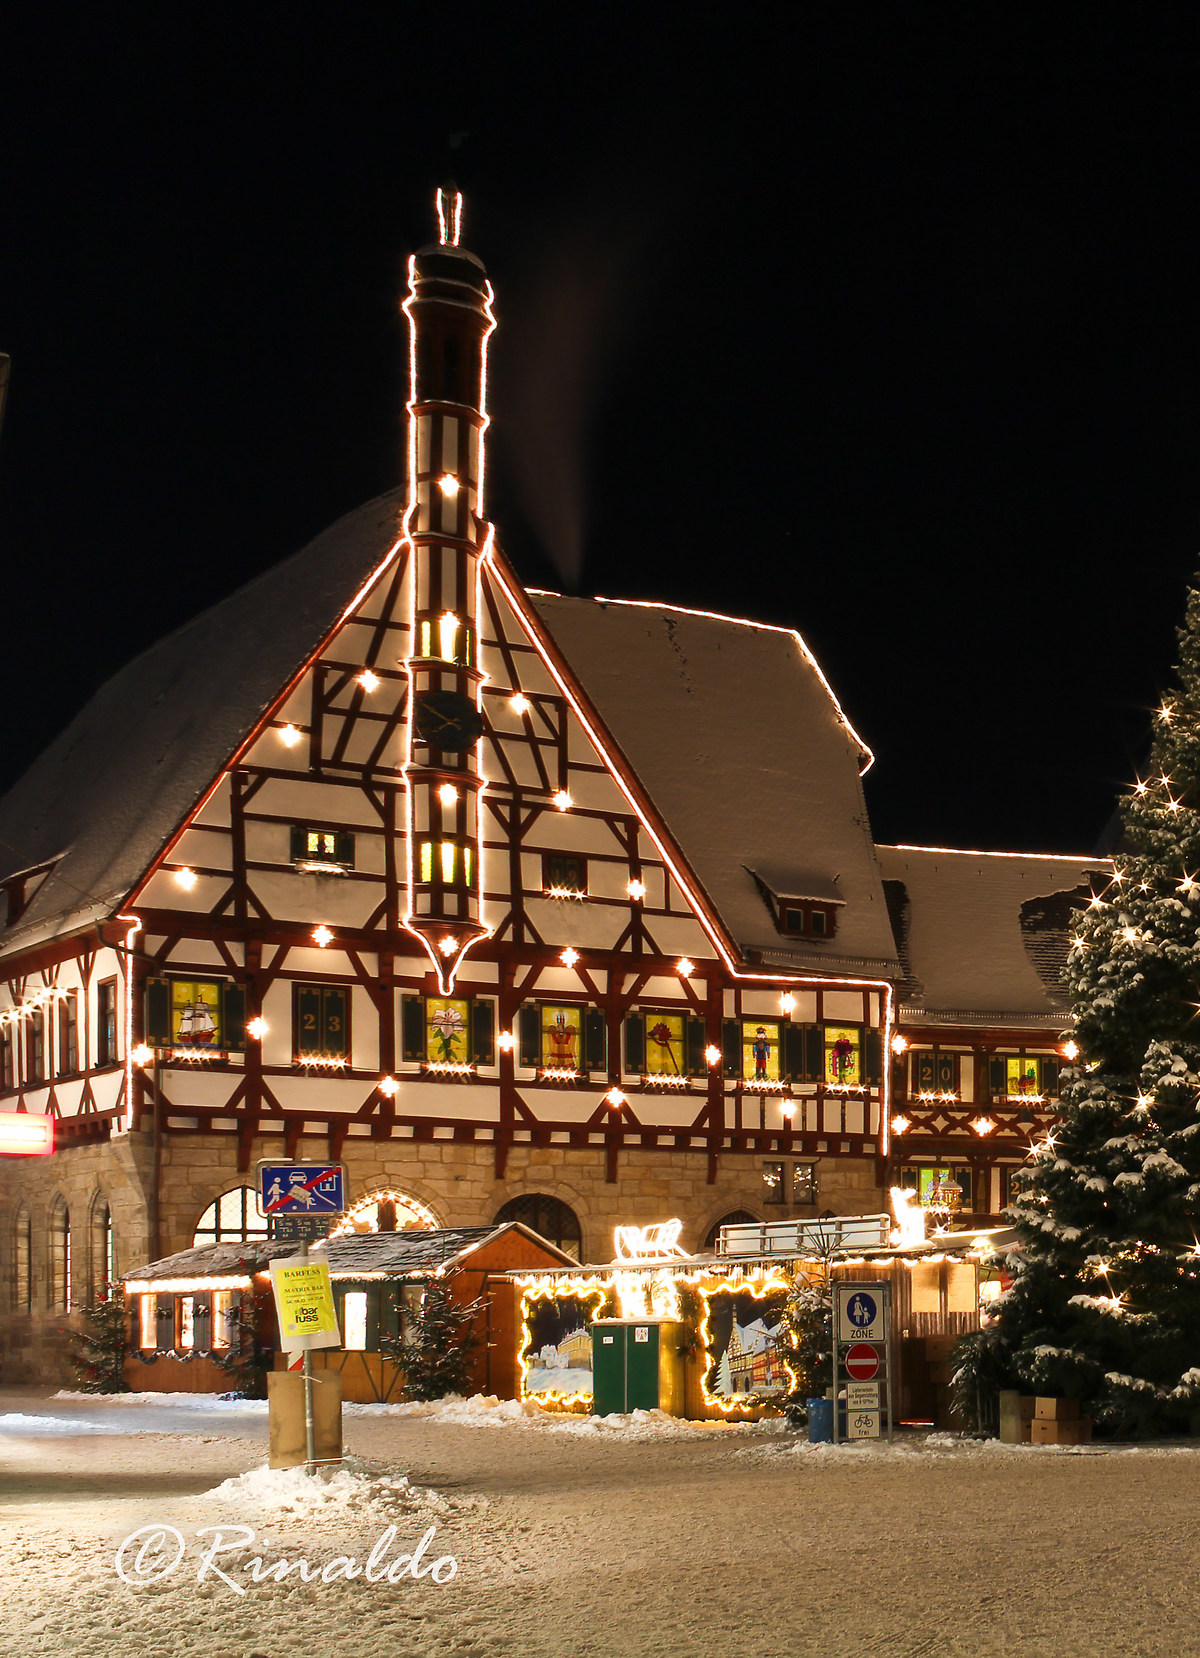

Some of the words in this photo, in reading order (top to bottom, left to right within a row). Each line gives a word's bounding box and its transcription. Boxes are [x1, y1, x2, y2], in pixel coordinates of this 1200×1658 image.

[284, 1269, 321, 1278] BARFUSS
[301, 1306, 318, 1315] bar
[295, 1314, 319, 1324] fuss
[851, 1329, 873, 1339] ZONE
